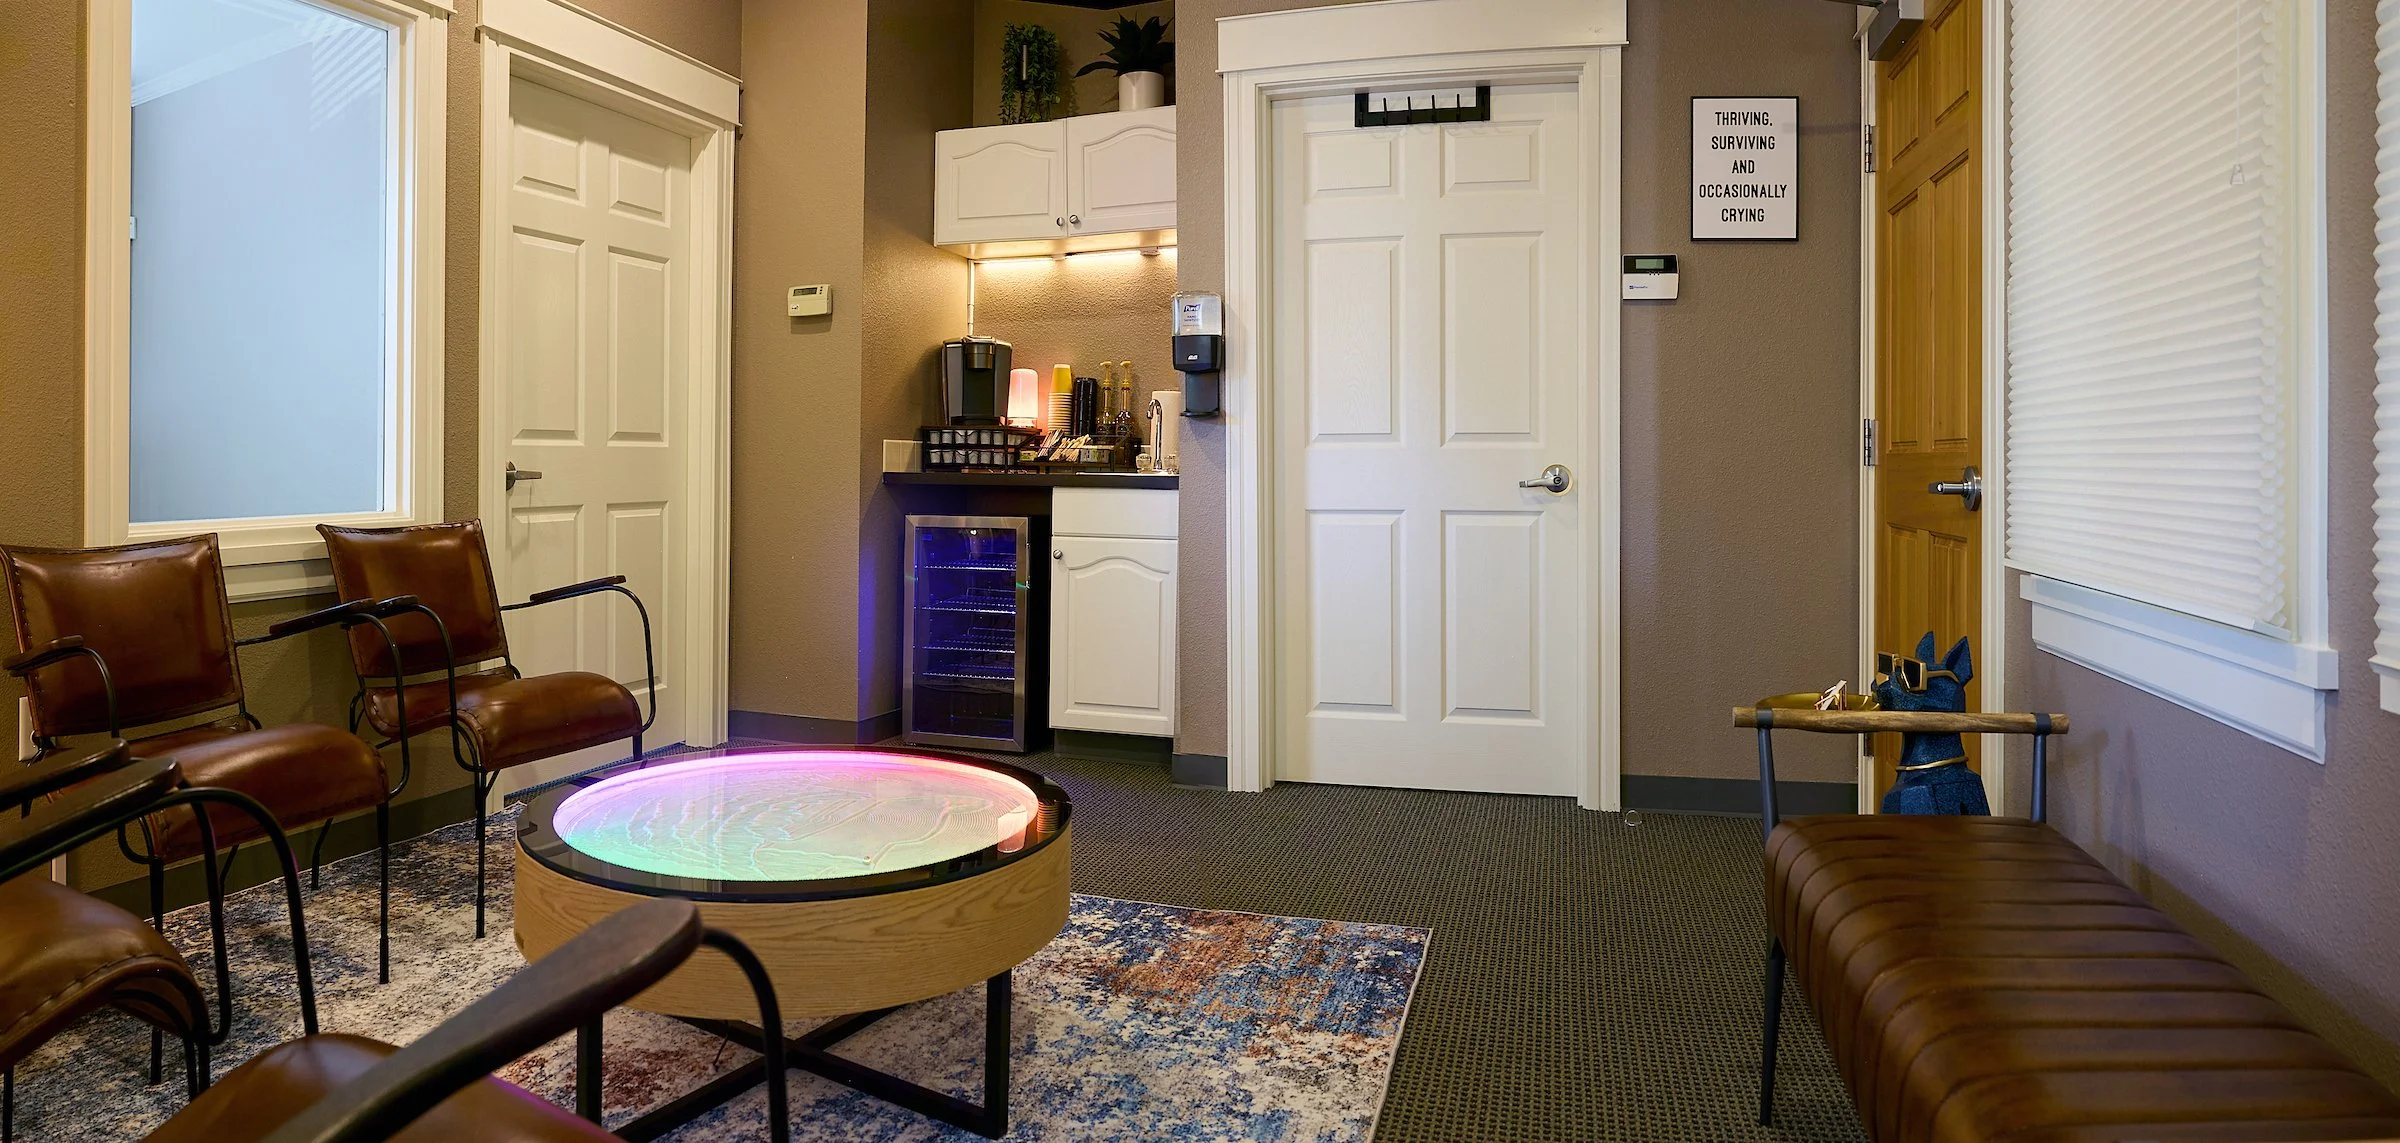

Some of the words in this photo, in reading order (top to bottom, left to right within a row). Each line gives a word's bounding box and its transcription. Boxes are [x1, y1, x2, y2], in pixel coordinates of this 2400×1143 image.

[1711, 135, 1776, 150] SURVIVING
[1731, 159, 1755, 174] AND
[1699, 184, 1788, 199] OCCASIONALLY
[1721, 208, 1765, 223] CRYING
